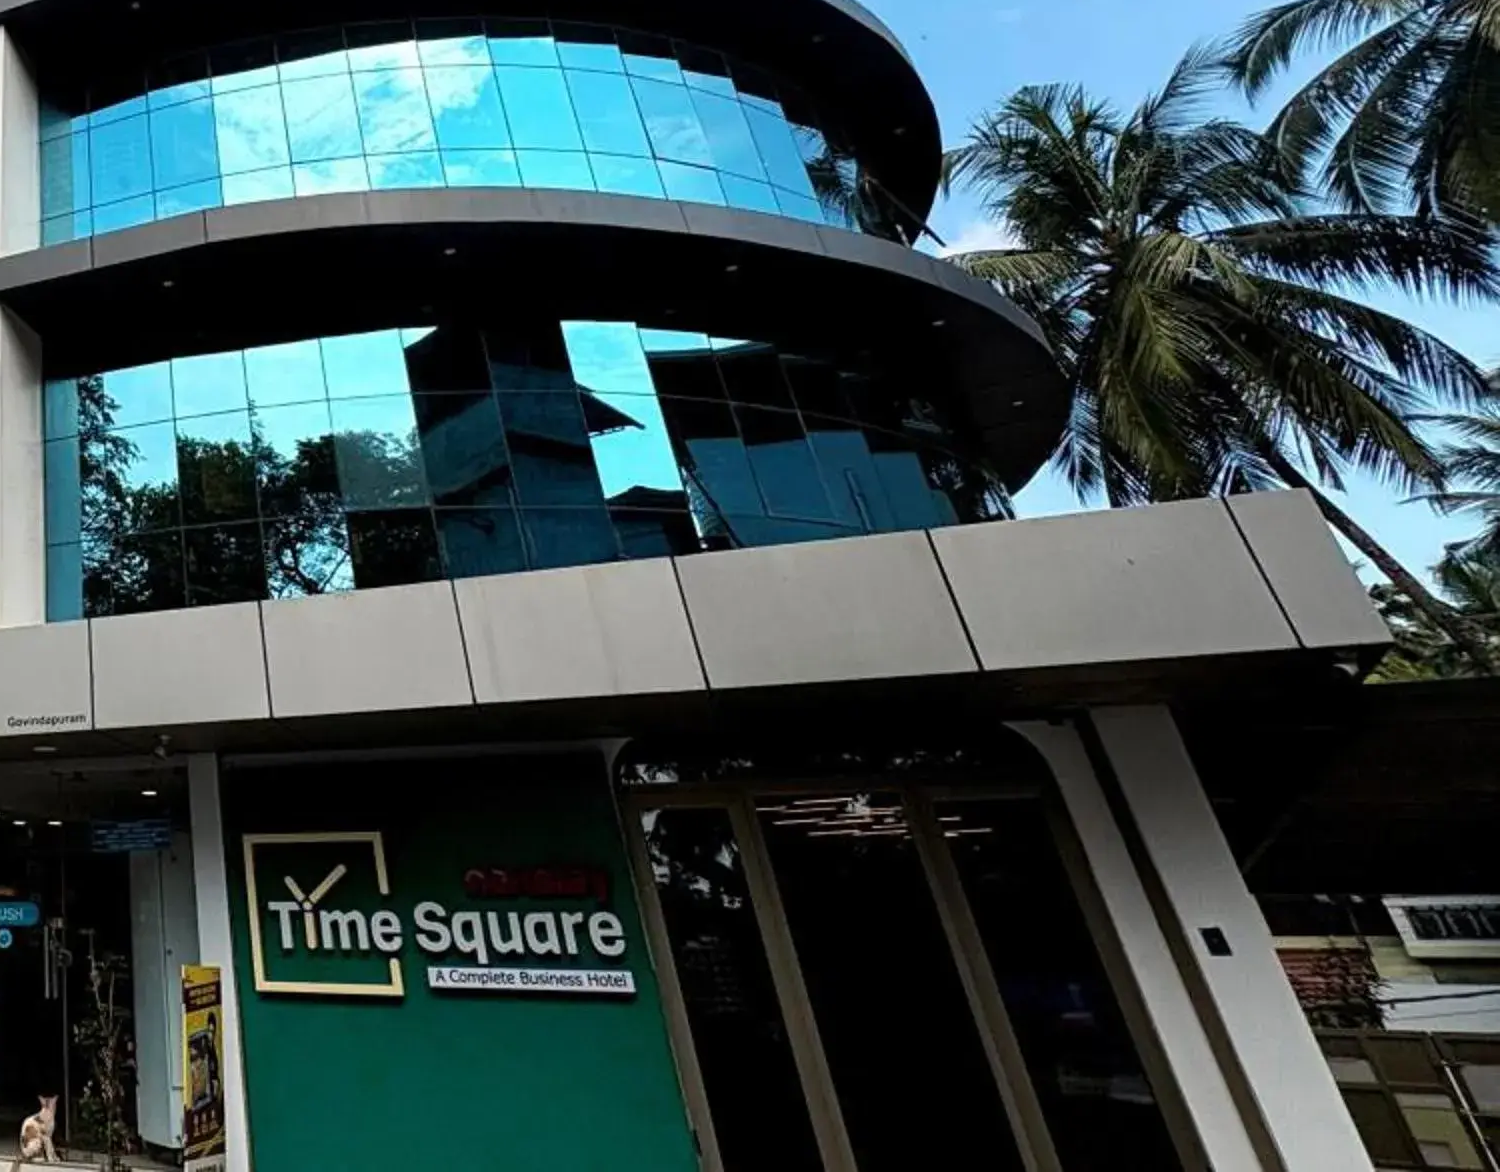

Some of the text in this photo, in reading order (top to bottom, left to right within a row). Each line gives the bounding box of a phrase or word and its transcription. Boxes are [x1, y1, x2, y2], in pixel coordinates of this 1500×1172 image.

[7, 714, 86, 727] Govindapuram
[268, 901, 626, 964] Time Square
[435, 970, 628, 987] A Complete Business Hotel
